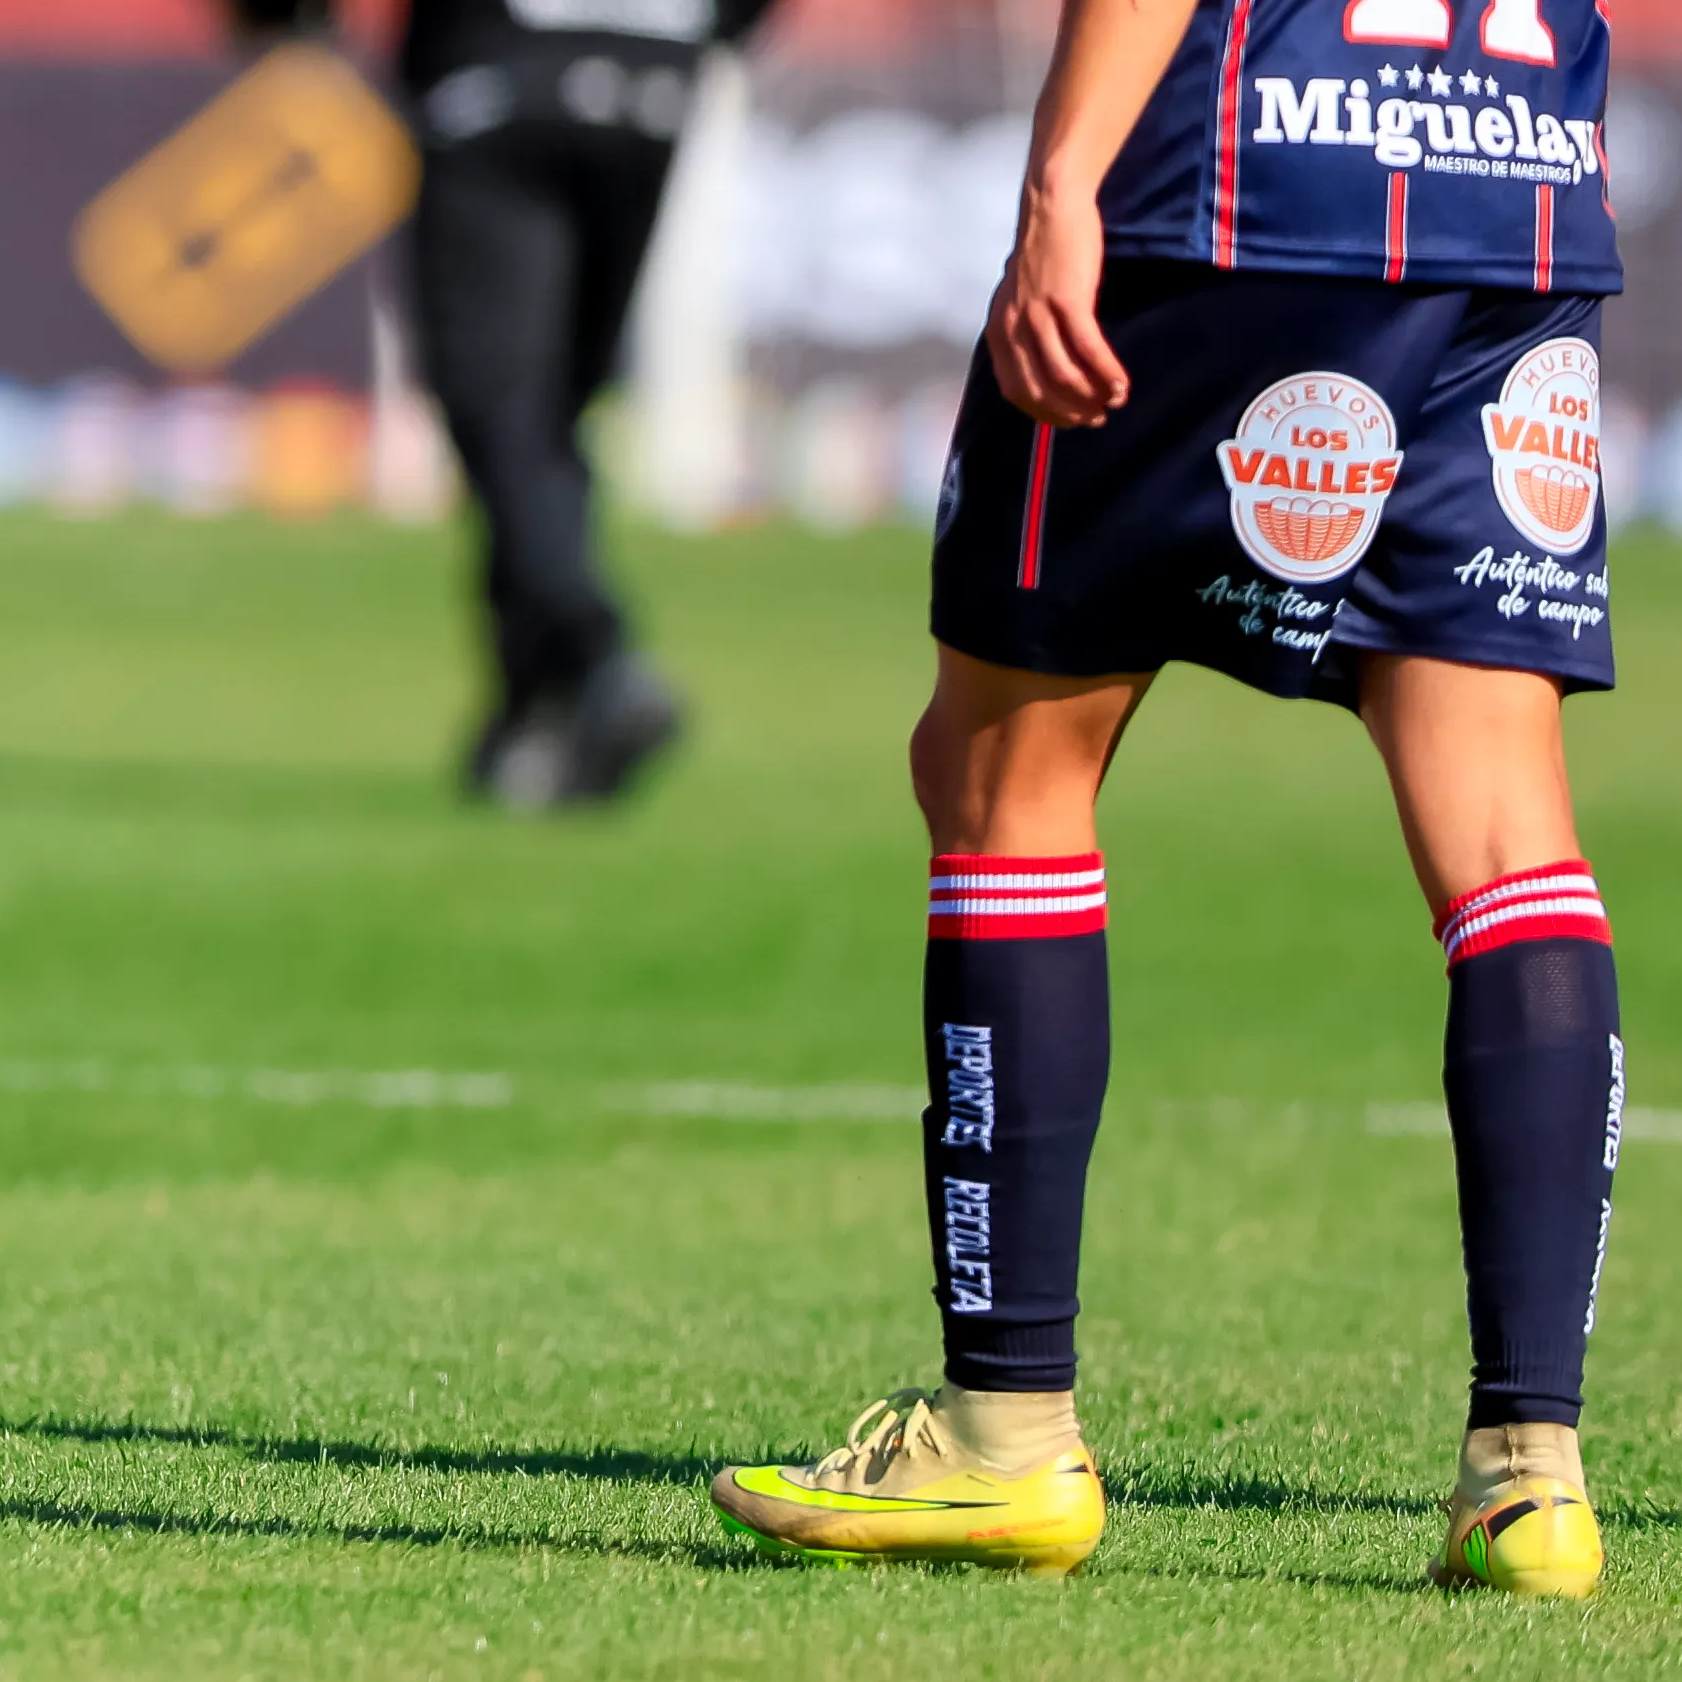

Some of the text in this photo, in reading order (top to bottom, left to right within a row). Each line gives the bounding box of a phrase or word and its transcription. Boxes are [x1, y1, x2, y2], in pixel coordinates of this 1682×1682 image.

[1252, 77, 1600, 185] Miguelay
[1424, 154, 1572, 186] MAESTRO DE MAESTROS
[1521, 350, 1598, 387] HUEVO
[1260, 382, 1380, 429] HUEVOS
[1548, 392, 1588, 422] LOS
[1291, 425, 1349, 451] LOS
[1227, 445, 1399, 494] VALLES
[1453, 545, 1581, 594] Auténtico
[1497, 581, 1605, 641] de campo
[942, 1022, 996, 1313] DEPORTES RECOLETA
